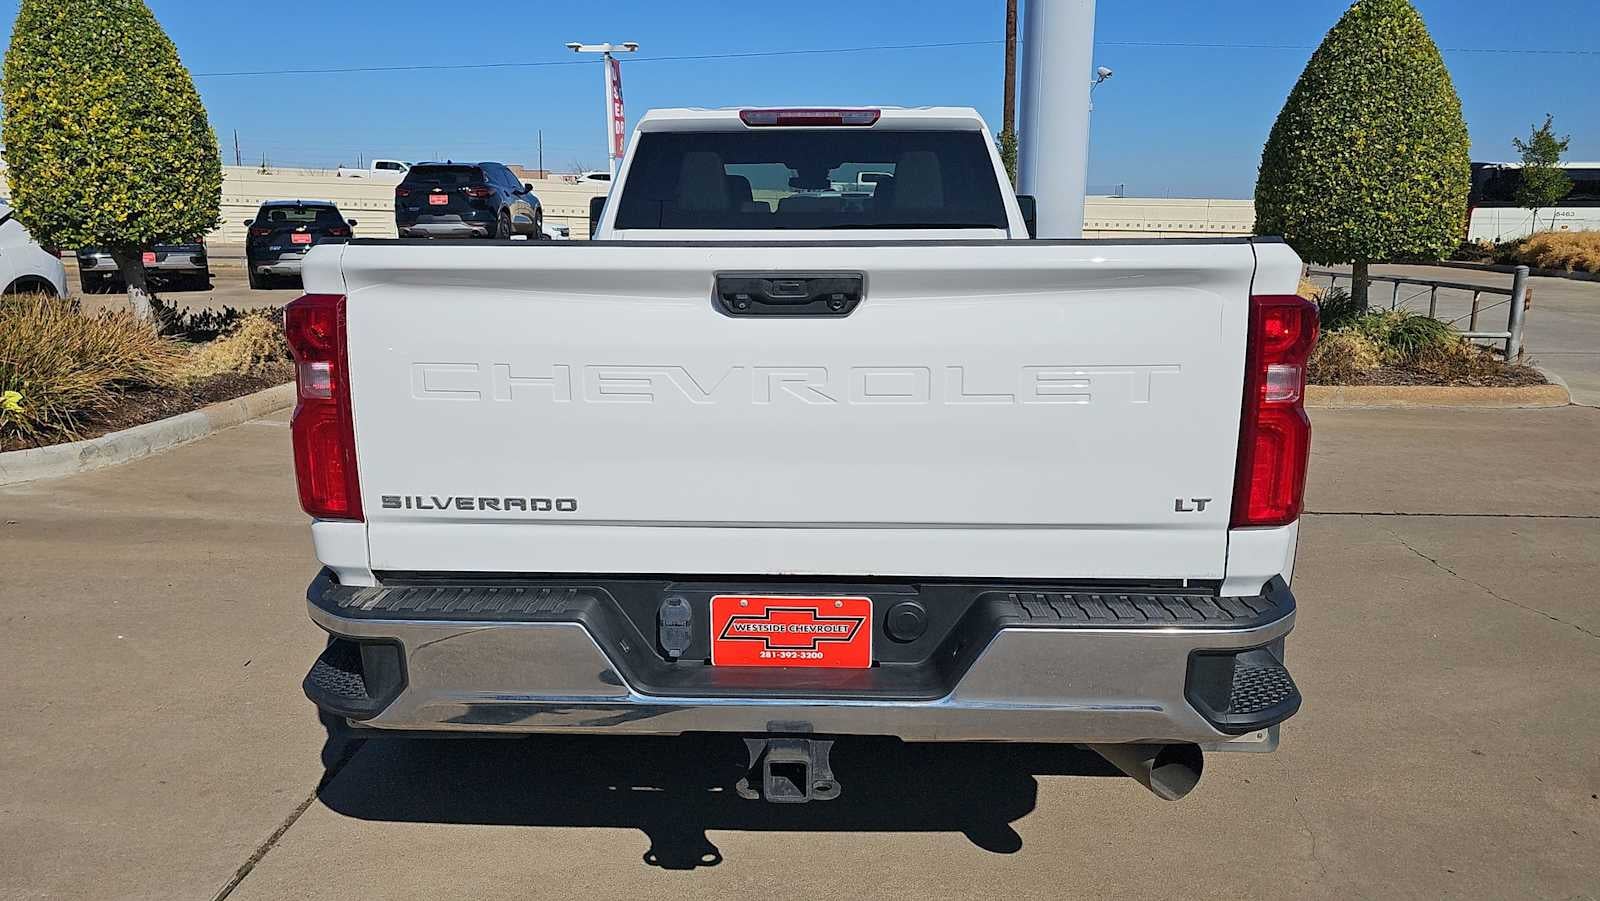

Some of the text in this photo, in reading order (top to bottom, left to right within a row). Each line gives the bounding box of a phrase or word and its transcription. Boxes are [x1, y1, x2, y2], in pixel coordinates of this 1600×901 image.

[411, 362, 1181, 405] CHEVROLET
[381, 495, 577, 512] SILVERADO
[1174, 498, 1212, 512] LT
[734, 622, 849, 633] WESTSIDE CHEVROLET
[759, 651, 824, 660] 281-392-3200
